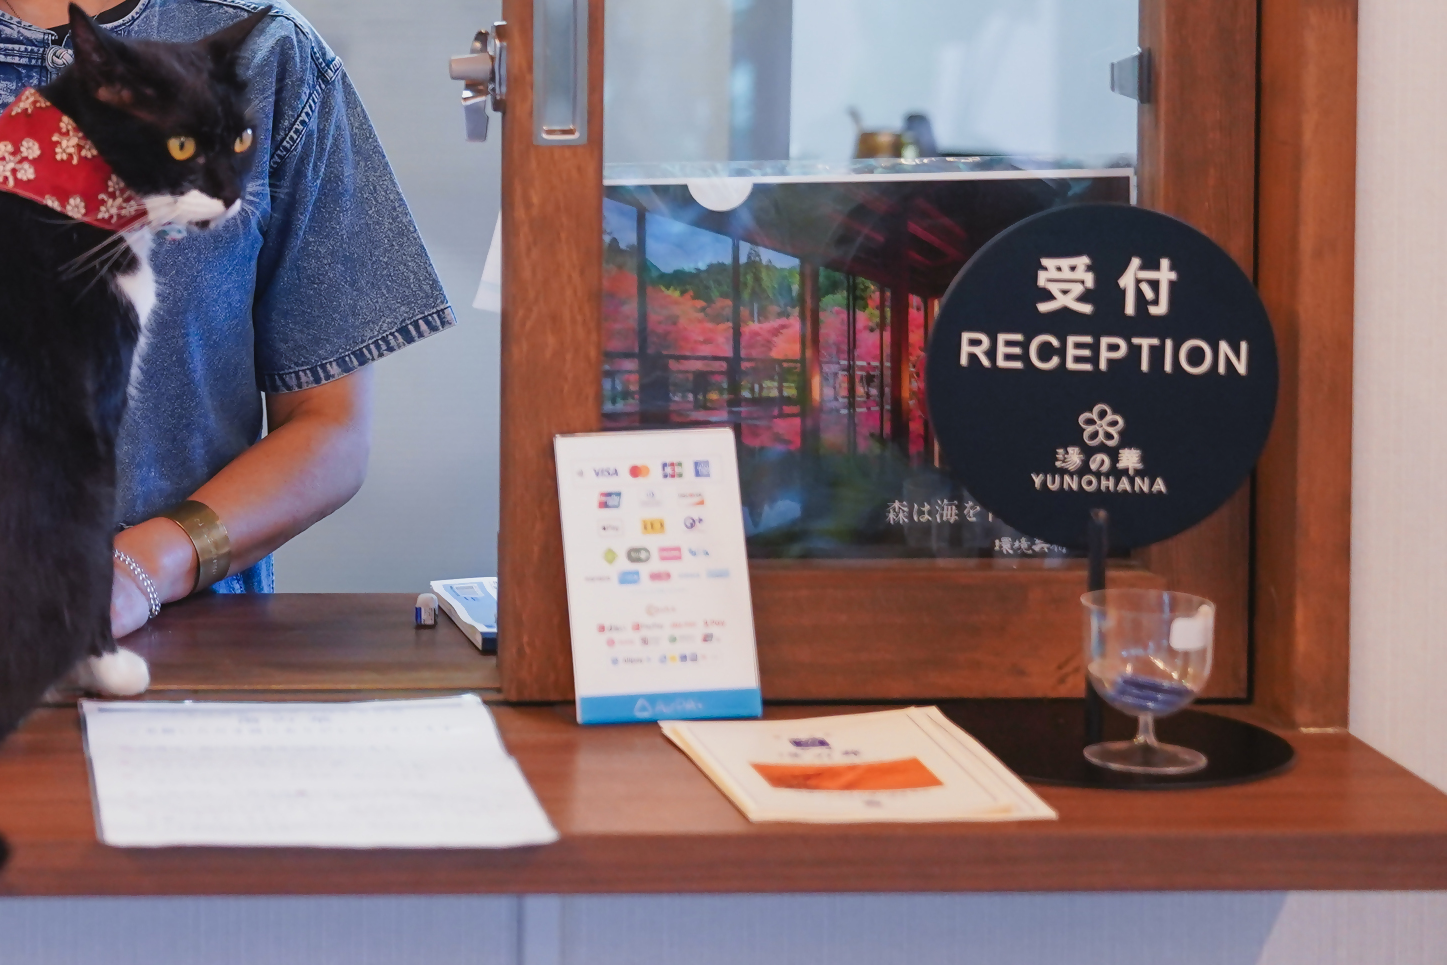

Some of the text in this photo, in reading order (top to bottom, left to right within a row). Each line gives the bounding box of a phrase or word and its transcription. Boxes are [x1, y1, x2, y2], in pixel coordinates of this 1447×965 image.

[1035, 254, 1178, 317] 受付
[959, 331, 1249, 376] RECEPTION
[593, 467, 619, 478] VISA
[1055, 447, 1144, 476] 湯の華
[1030, 473, 1168, 495] YUNOHANA
[885, 499, 993, 525] 森は海を
